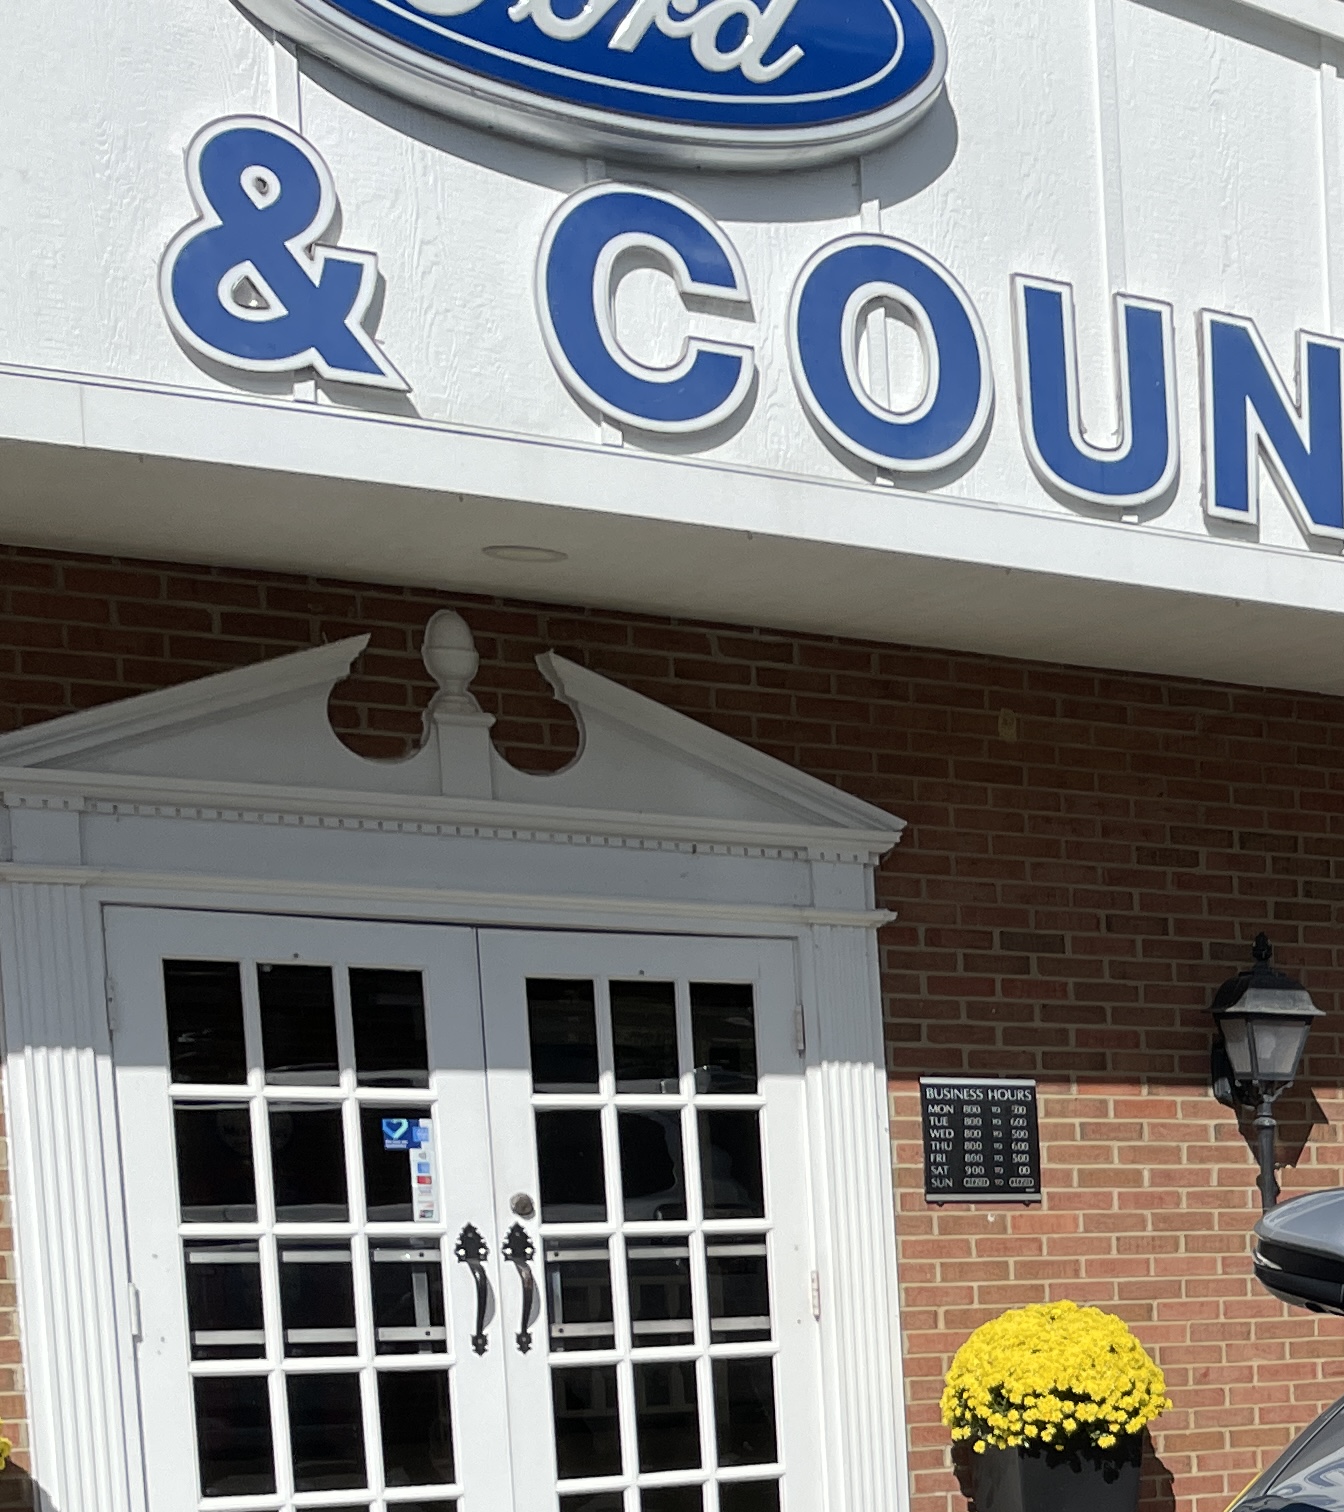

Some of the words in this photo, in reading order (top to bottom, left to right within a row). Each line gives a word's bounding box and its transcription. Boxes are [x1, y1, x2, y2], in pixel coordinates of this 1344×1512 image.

[404, 0, 804, 84] ord
[160, 115, 413, 392] &
[926, 1087, 984, 1100] BUSINESS
[987, 1089, 1032, 1101] HOURS
[928, 1104, 954, 1114] MON
[929, 1117, 949, 1126] TUE
[929, 1129, 955, 1139] WED
[930, 1141, 953, 1151] THU
[930, 1153, 947, 1163] FRI
[930, 1166, 950, 1175] SAT
[931, 1178, 953, 1188] SUN
